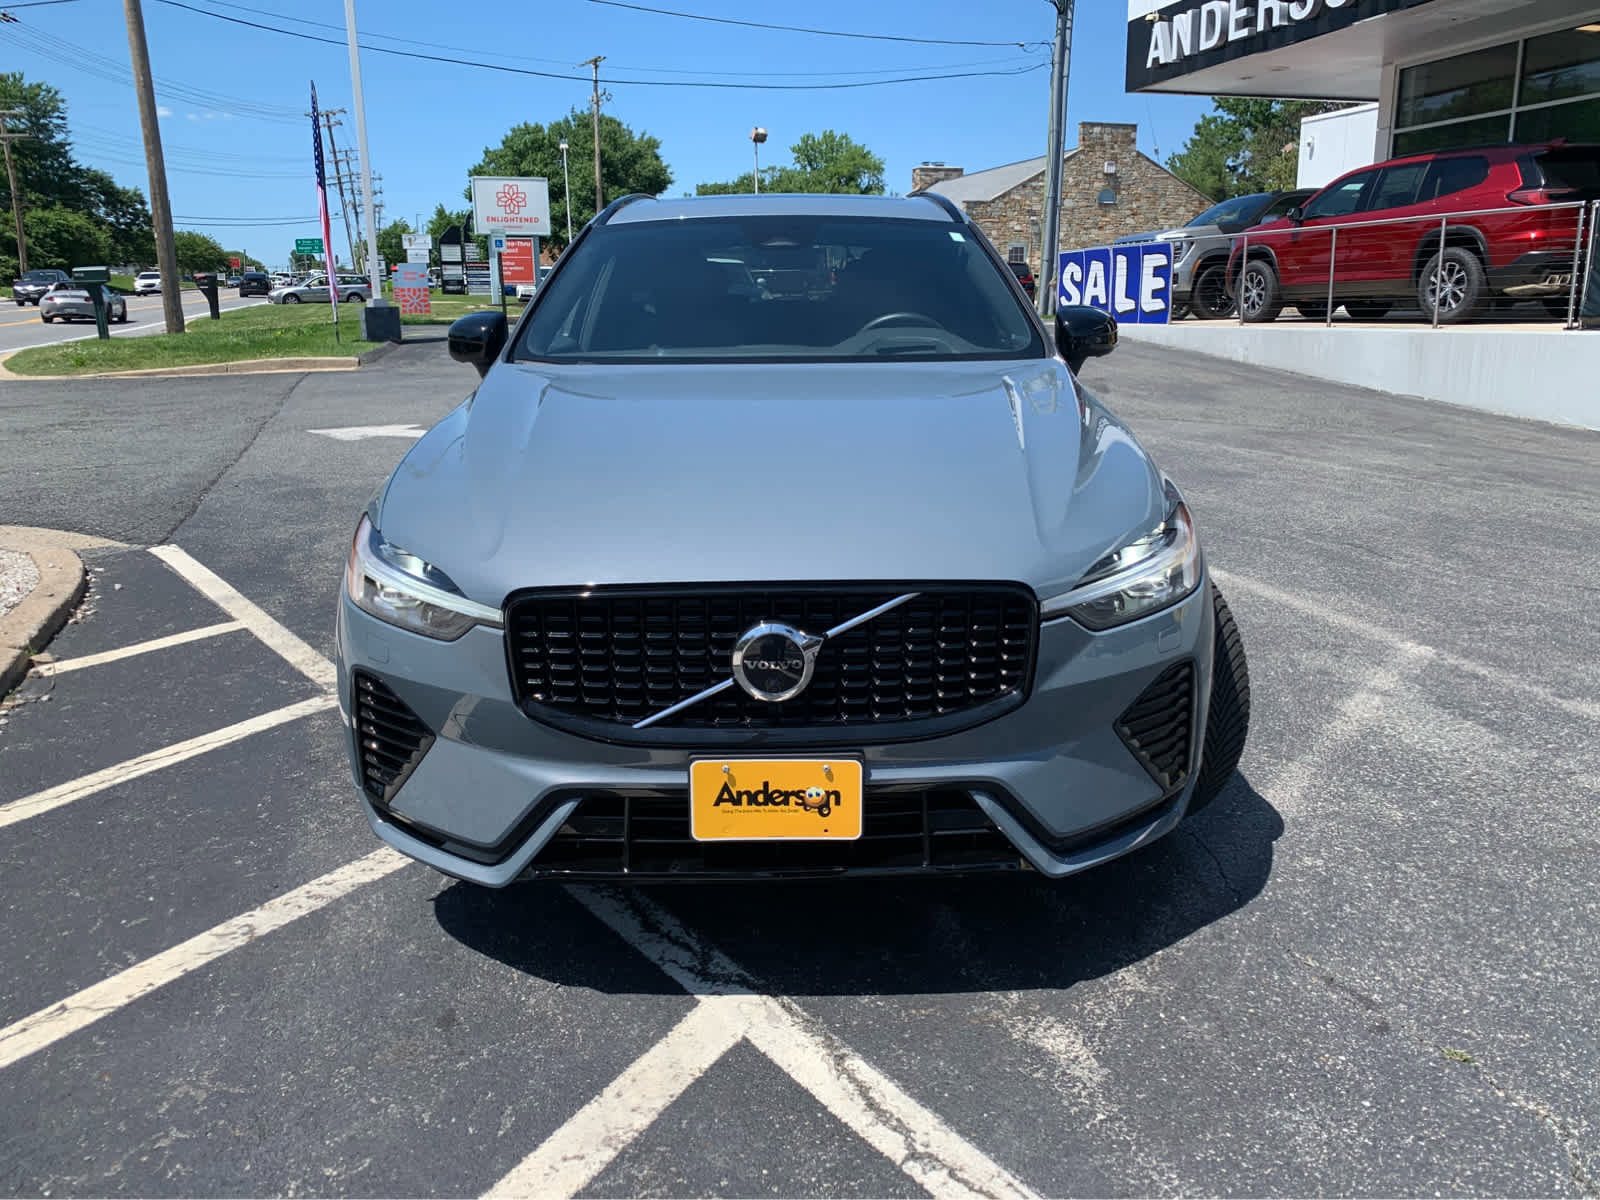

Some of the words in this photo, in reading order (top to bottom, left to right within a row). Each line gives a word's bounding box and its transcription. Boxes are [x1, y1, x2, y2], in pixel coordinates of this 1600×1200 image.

[1146, 0, 1346, 68] ANDER
[486, 216, 539, 224] ENLIGHTENED
[1060, 253, 1168, 313] SALE
[744, 660, 802, 669] VOLVO
[713, 781, 841, 807] Anderson
